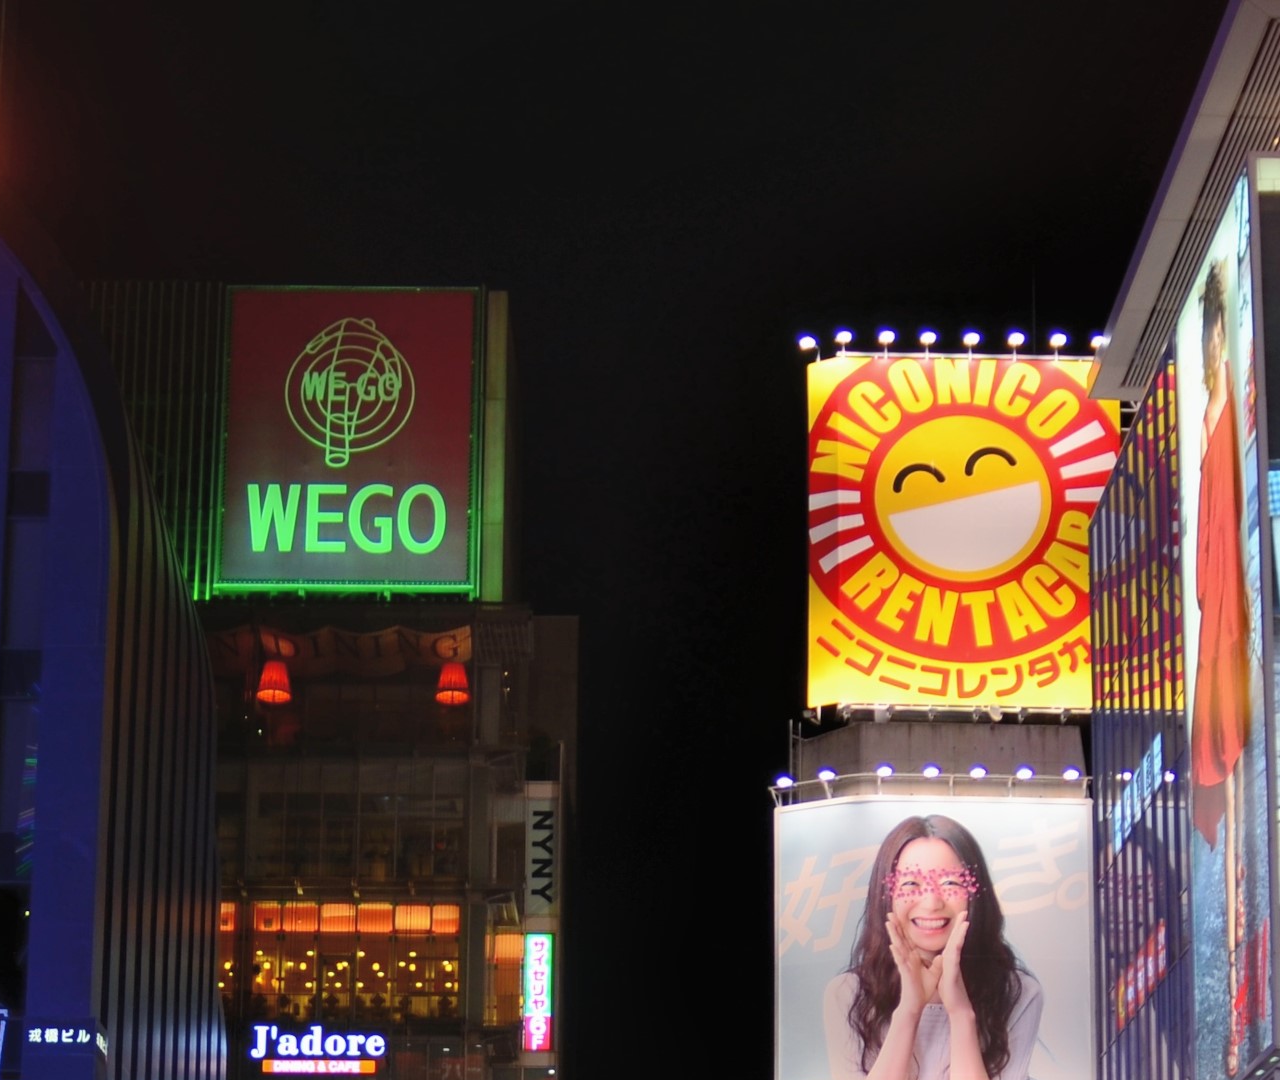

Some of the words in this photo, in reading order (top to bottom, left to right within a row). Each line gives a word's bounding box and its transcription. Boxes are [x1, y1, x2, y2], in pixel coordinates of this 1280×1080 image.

[304, 371, 347, 401] WE
[357, 371, 400, 401] GO
[810, 357, 1081, 483] NICONICO
[247, 483, 448, 554] WEGO
[531, 809, 554, 905] NYNY
[251, 1025, 385, 1057] J'adore
[273, 1060, 315, 1073] DINING
[329, 1060, 361, 1073] CAFE
